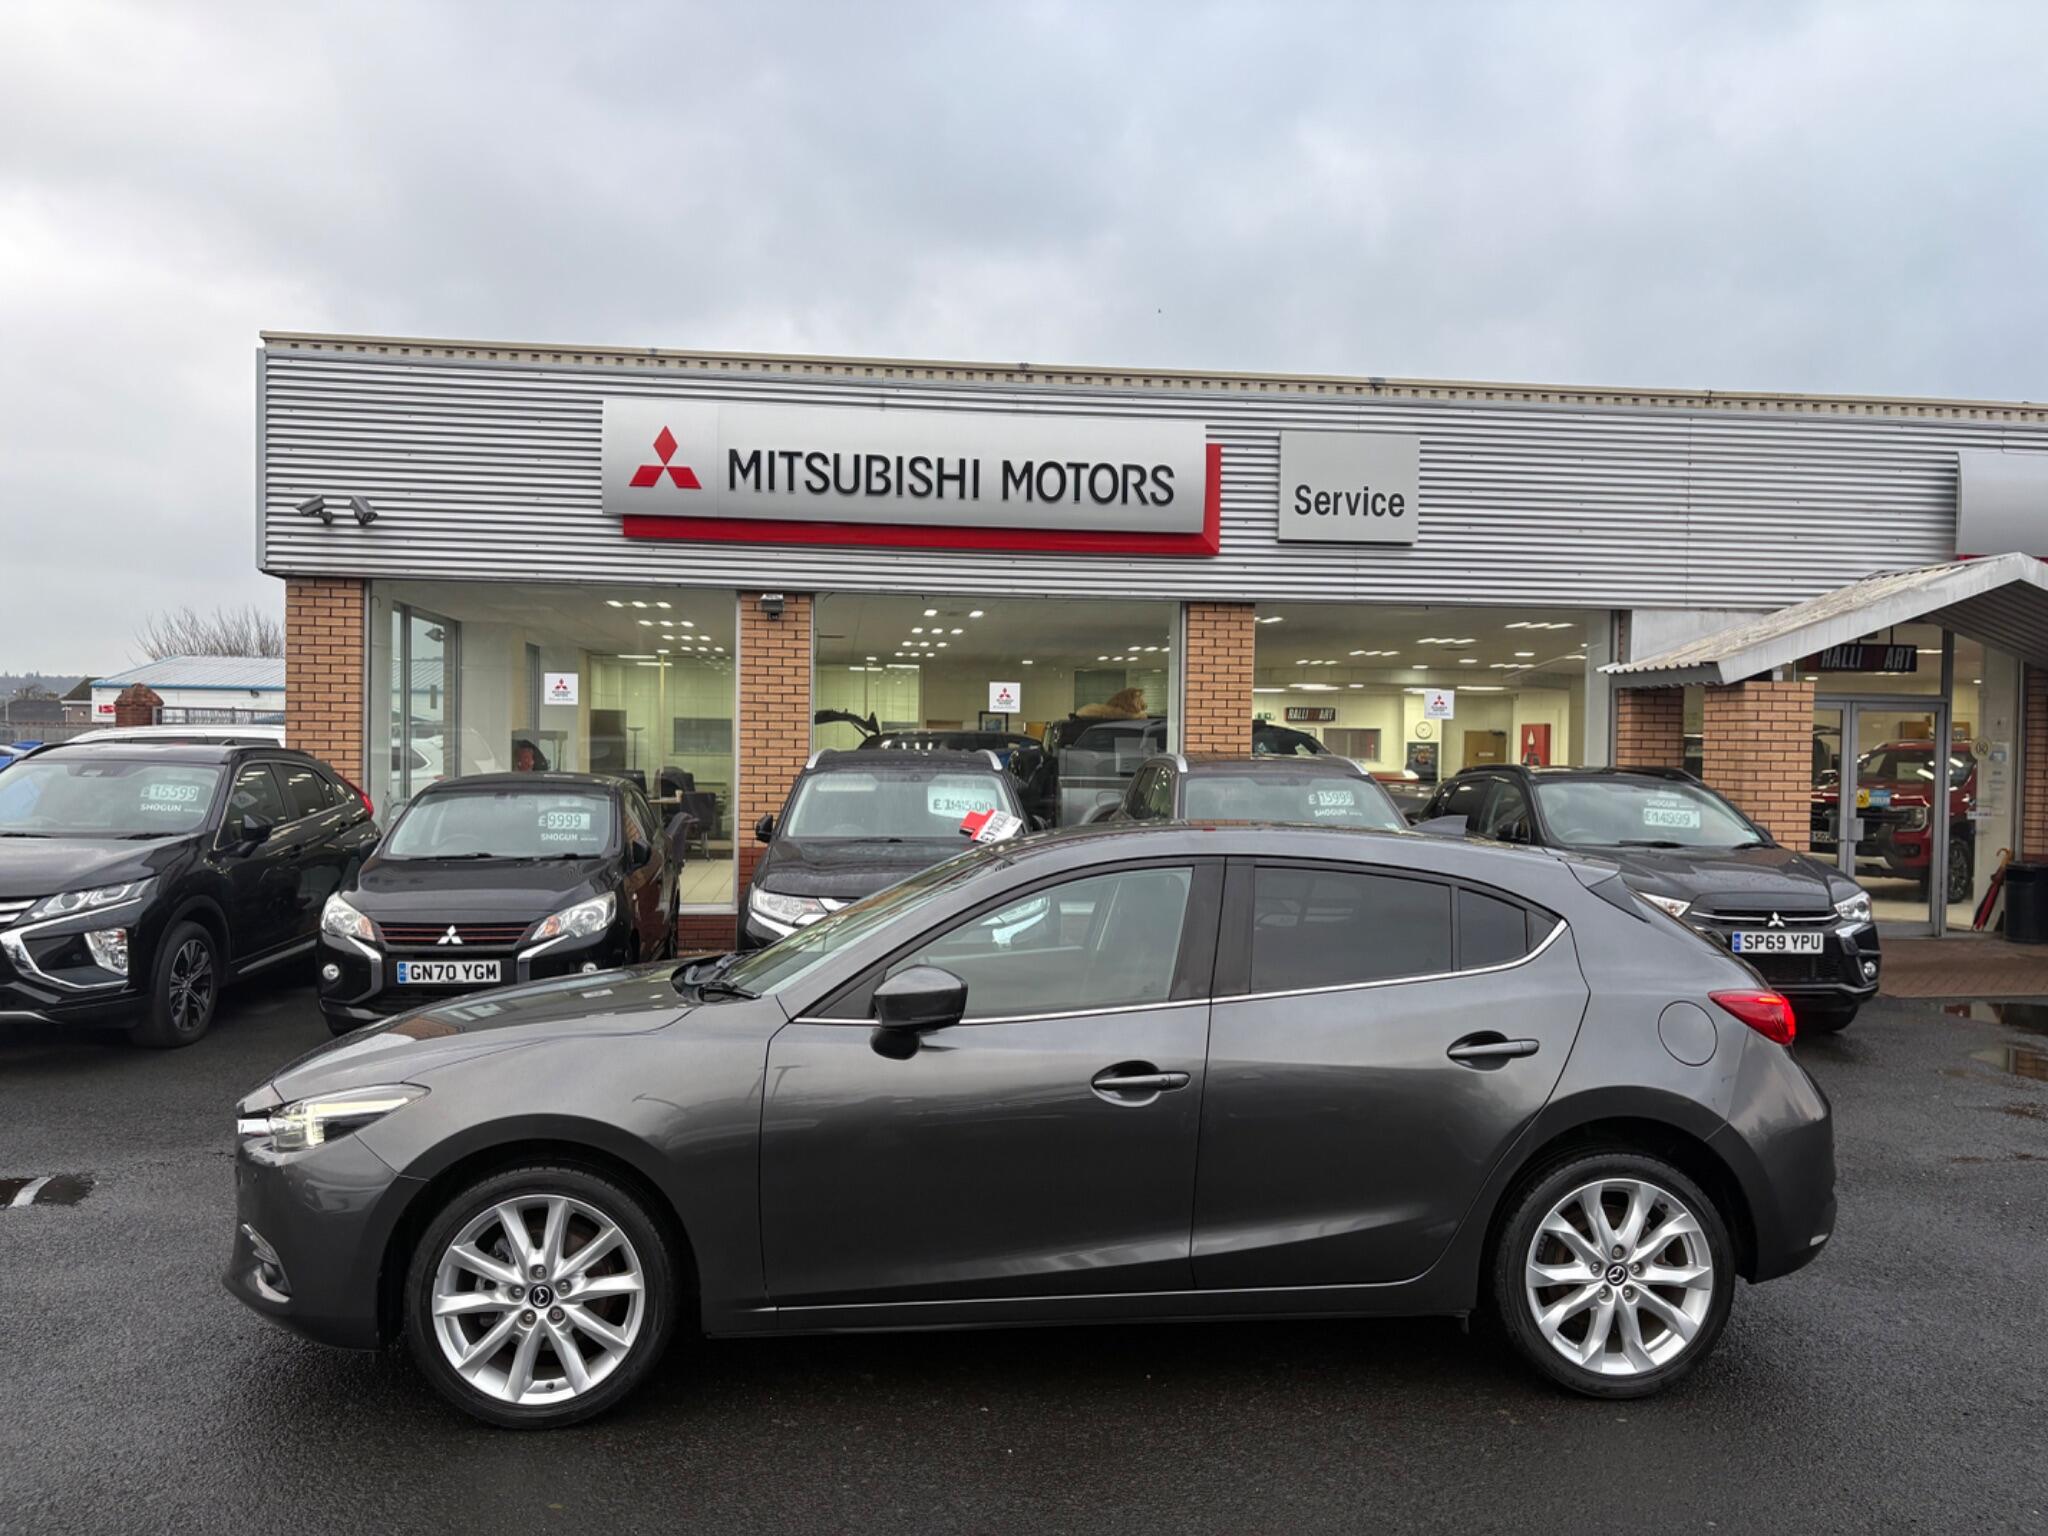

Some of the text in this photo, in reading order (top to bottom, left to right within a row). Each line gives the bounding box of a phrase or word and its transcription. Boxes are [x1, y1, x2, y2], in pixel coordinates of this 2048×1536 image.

[728, 448, 1175, 506] MITSUBISHI MOTORS
[1294, 484, 1405, 517] Service
[140, 803, 181, 812] SHOGUN
[541, 833, 578, 841] SHOGUN
[1744, 934, 1820, 950] SP69 YPU
[410, 964, 497, 981] GN70 YGM
